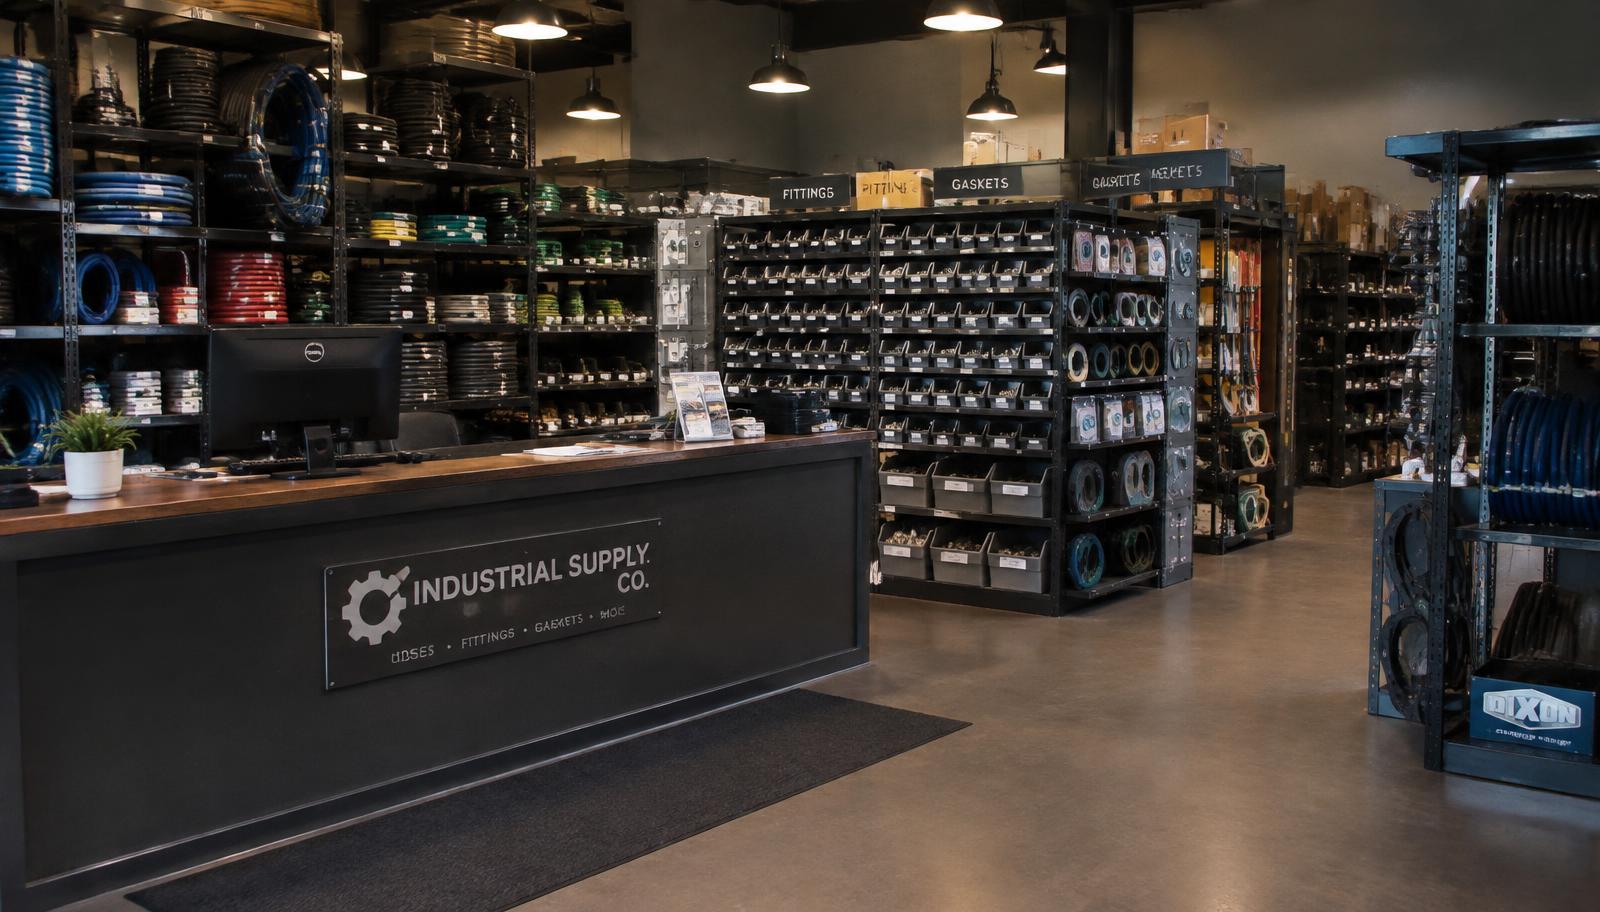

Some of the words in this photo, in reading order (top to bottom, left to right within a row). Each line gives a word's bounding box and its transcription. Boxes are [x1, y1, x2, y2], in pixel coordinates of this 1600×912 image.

[951, 177, 1009, 191] GASKETS
[413, 558, 563, 606] INDUSTRIAL
[617, 570, 650, 593] CO.
[461, 628, 515, 649] FITTINGS
[1487, 695, 1577, 725] DIXON
